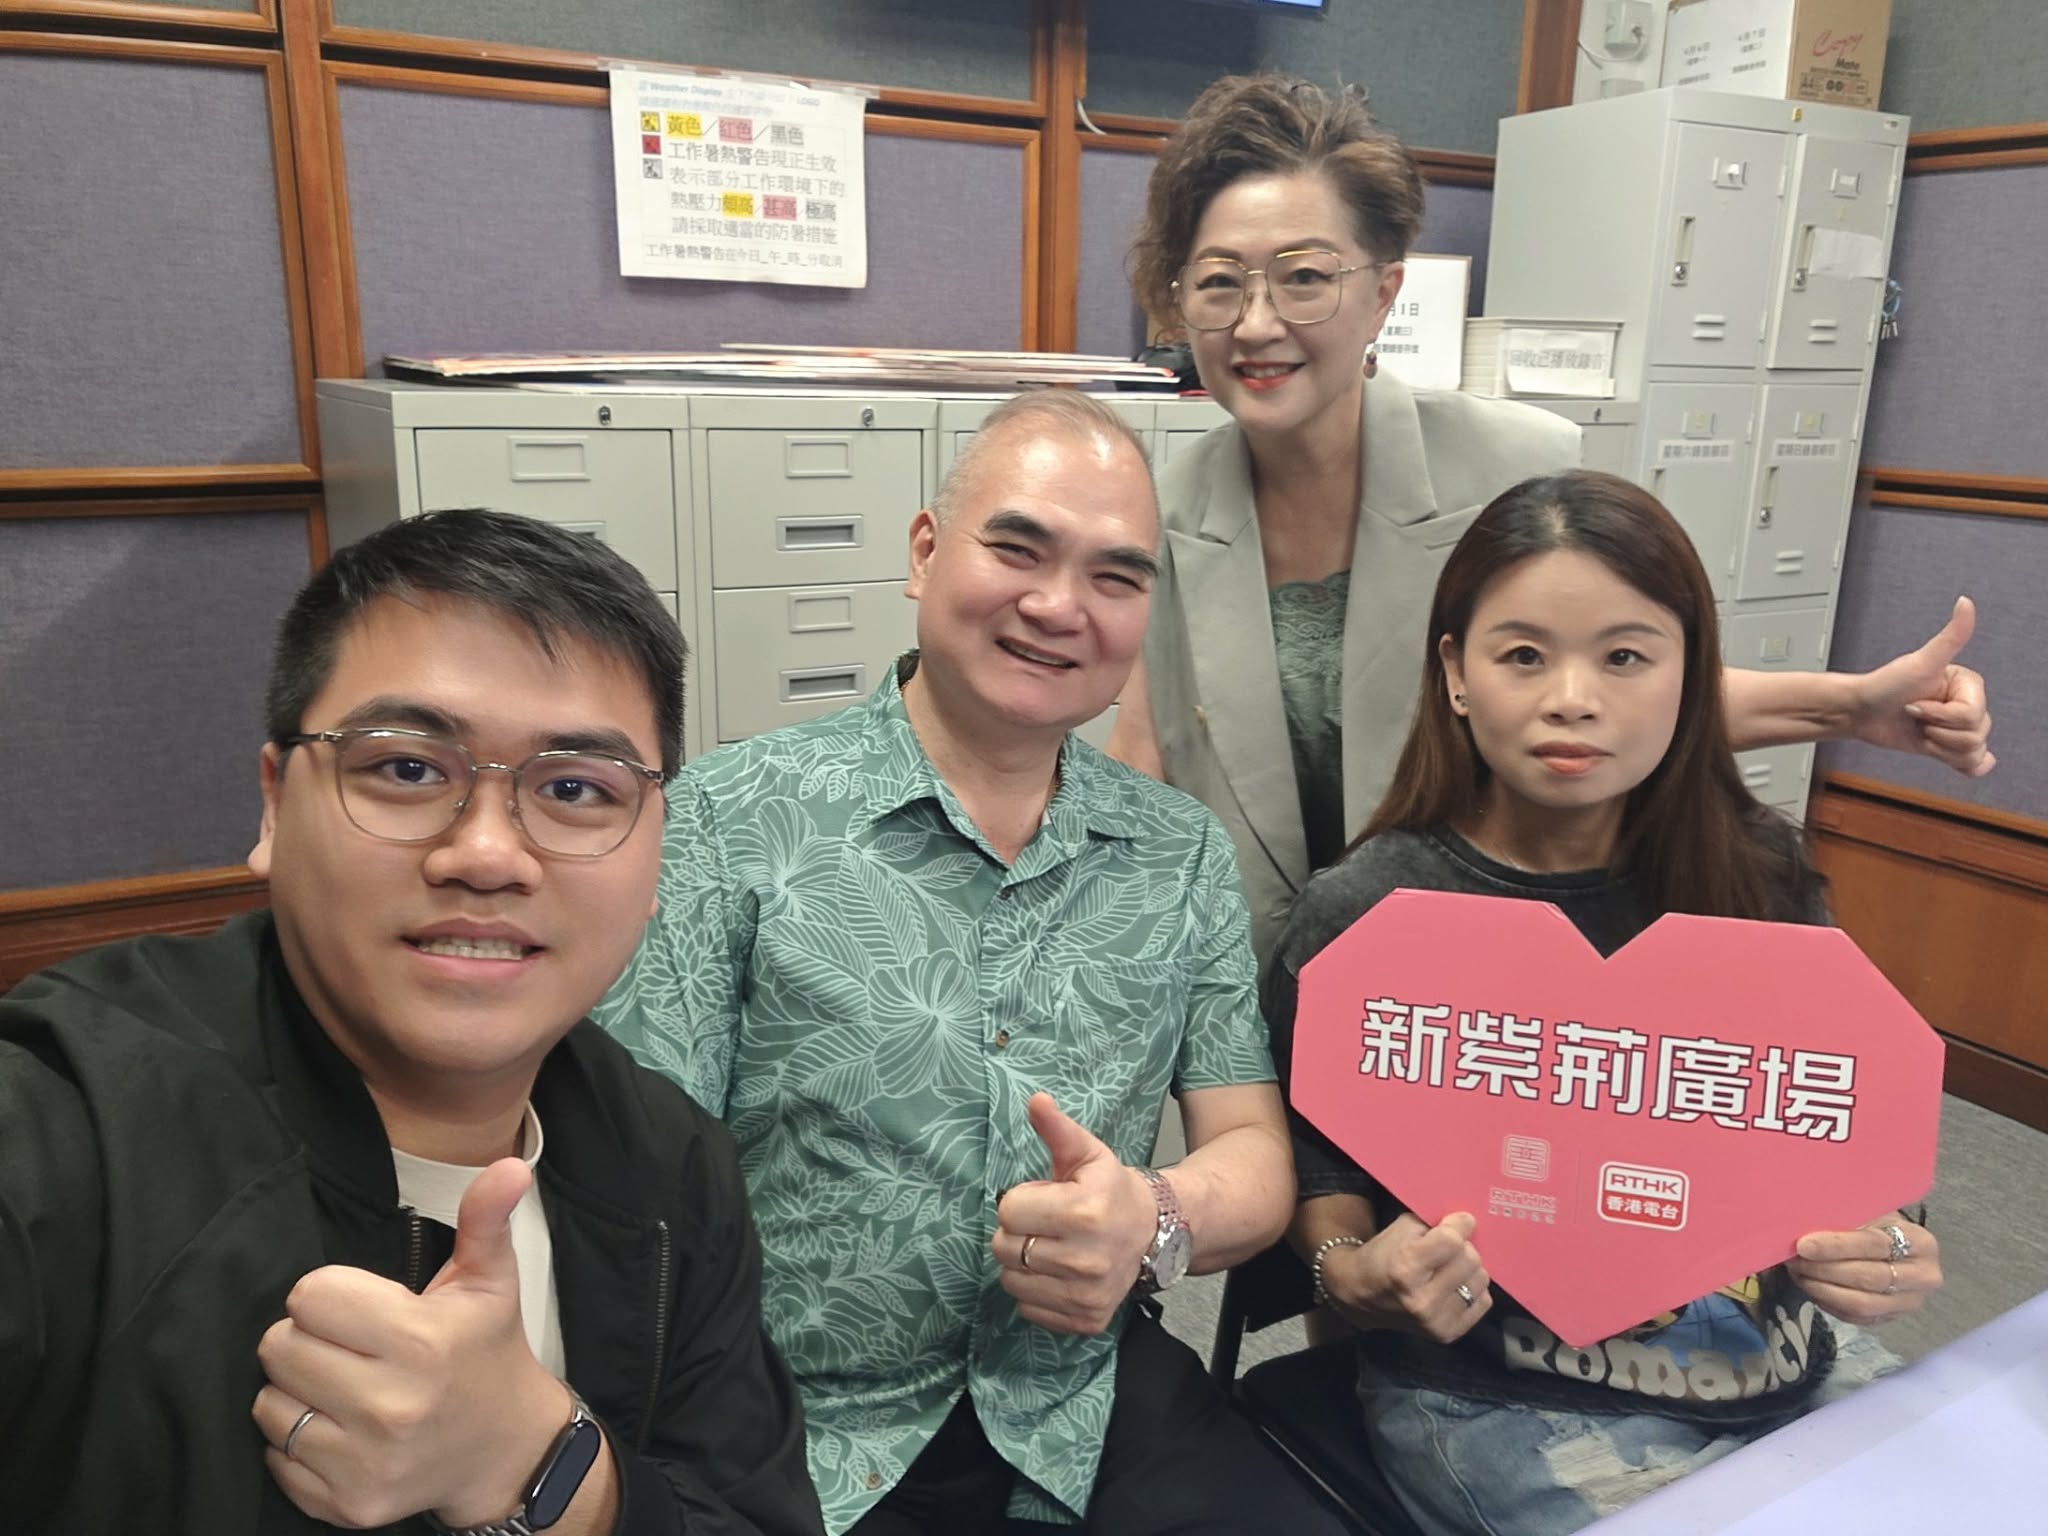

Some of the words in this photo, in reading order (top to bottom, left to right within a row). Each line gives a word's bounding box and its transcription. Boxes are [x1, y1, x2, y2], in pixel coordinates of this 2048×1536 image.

[1359, 996, 1858, 1144] 新紫荊廣場
[1610, 1172, 1680, 1196] RTHK
[1606, 1195, 1680, 1220] 香港電台
